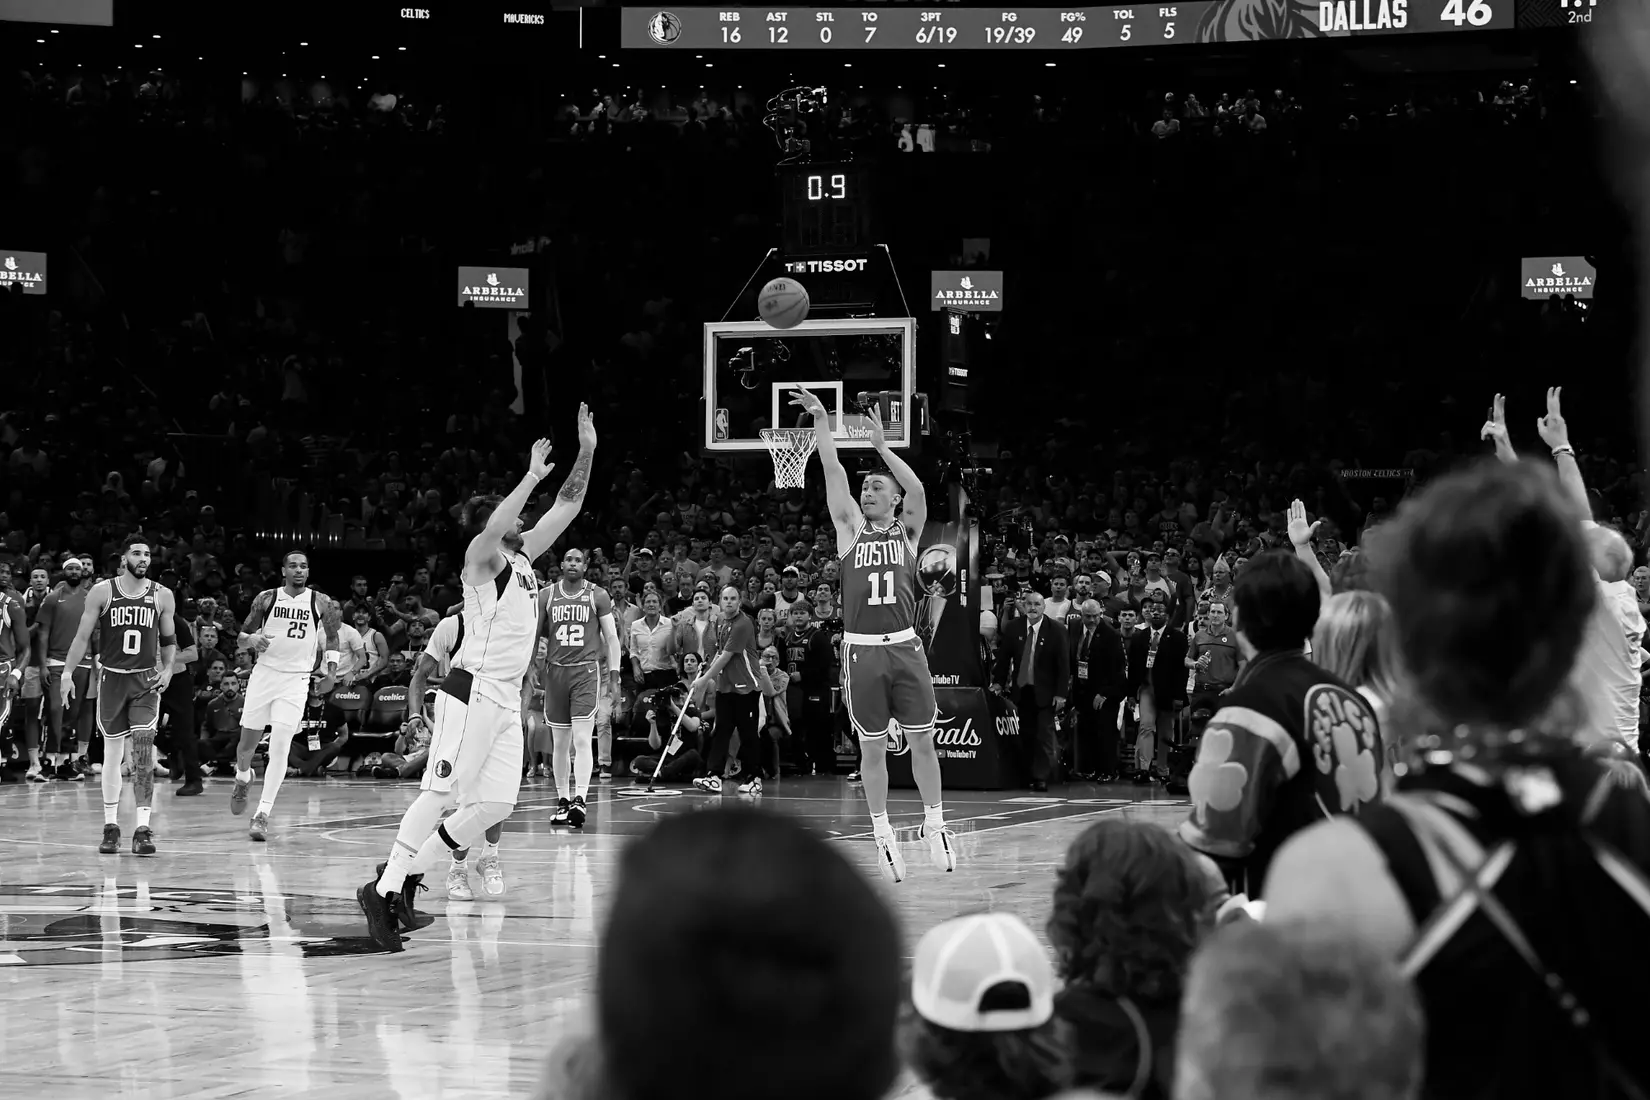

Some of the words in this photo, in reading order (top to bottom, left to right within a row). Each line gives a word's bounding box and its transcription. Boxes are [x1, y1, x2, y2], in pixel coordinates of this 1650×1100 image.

[401, 8, 430, 19] CELTICS
[503, 13, 545, 25] MAVERICKS
[719, 12, 740, 22] REB
[766, 12, 788, 22] AST
[816, 12, 834, 22] STL
[861, 12, 878, 22] TO
[920, 12, 942, 22] 3PT
[1002, 12, 1017, 22] FG
[1061, 12, 1086, 22] FG%
[1113, 9, 1135, 20] TOL
[1159, 7, 1178, 17] FLS
[1319, 0, 1407, 31] DALLAS
[1440, 0, 1492, 26] 46
[1567, 9, 1592, 24] 2nd
[720, 26, 742, 43] 16
[768, 26, 788, 43] 12
[819, 26, 832, 43] 0
[864, 26, 877, 43] 7
[915, 26, 957, 44] 6/19
[985, 26, 1036, 44] 19/39
[1061, 26, 1083, 43] 49
[1120, 24, 1132, 41] 5
[1163, 22, 1175, 39] 5
[807, 174, 846, 200] 0.9
[807, 258, 868, 273] TISSOT
[1525, 276, 1592, 287] ARBELLA
[462, 286, 525, 296] ARBELLA
[935, 290, 999, 299] ARBELLA
[854, 539, 905, 569] BOSTON
[867, 571, 897, 606] 11
[110, 605, 155, 629] BOSTON
[273, 606, 310, 621] DALLAS
[551, 604, 590, 624] BOSTON
[287, 621, 308, 640] 25
[555, 624, 585, 647] 42
[122, 629, 141, 655] 0
[335, 691, 361, 700] @celtics
[378, 693, 405, 702] @celtics
[946, 749, 977, 759] YouTubeTV
